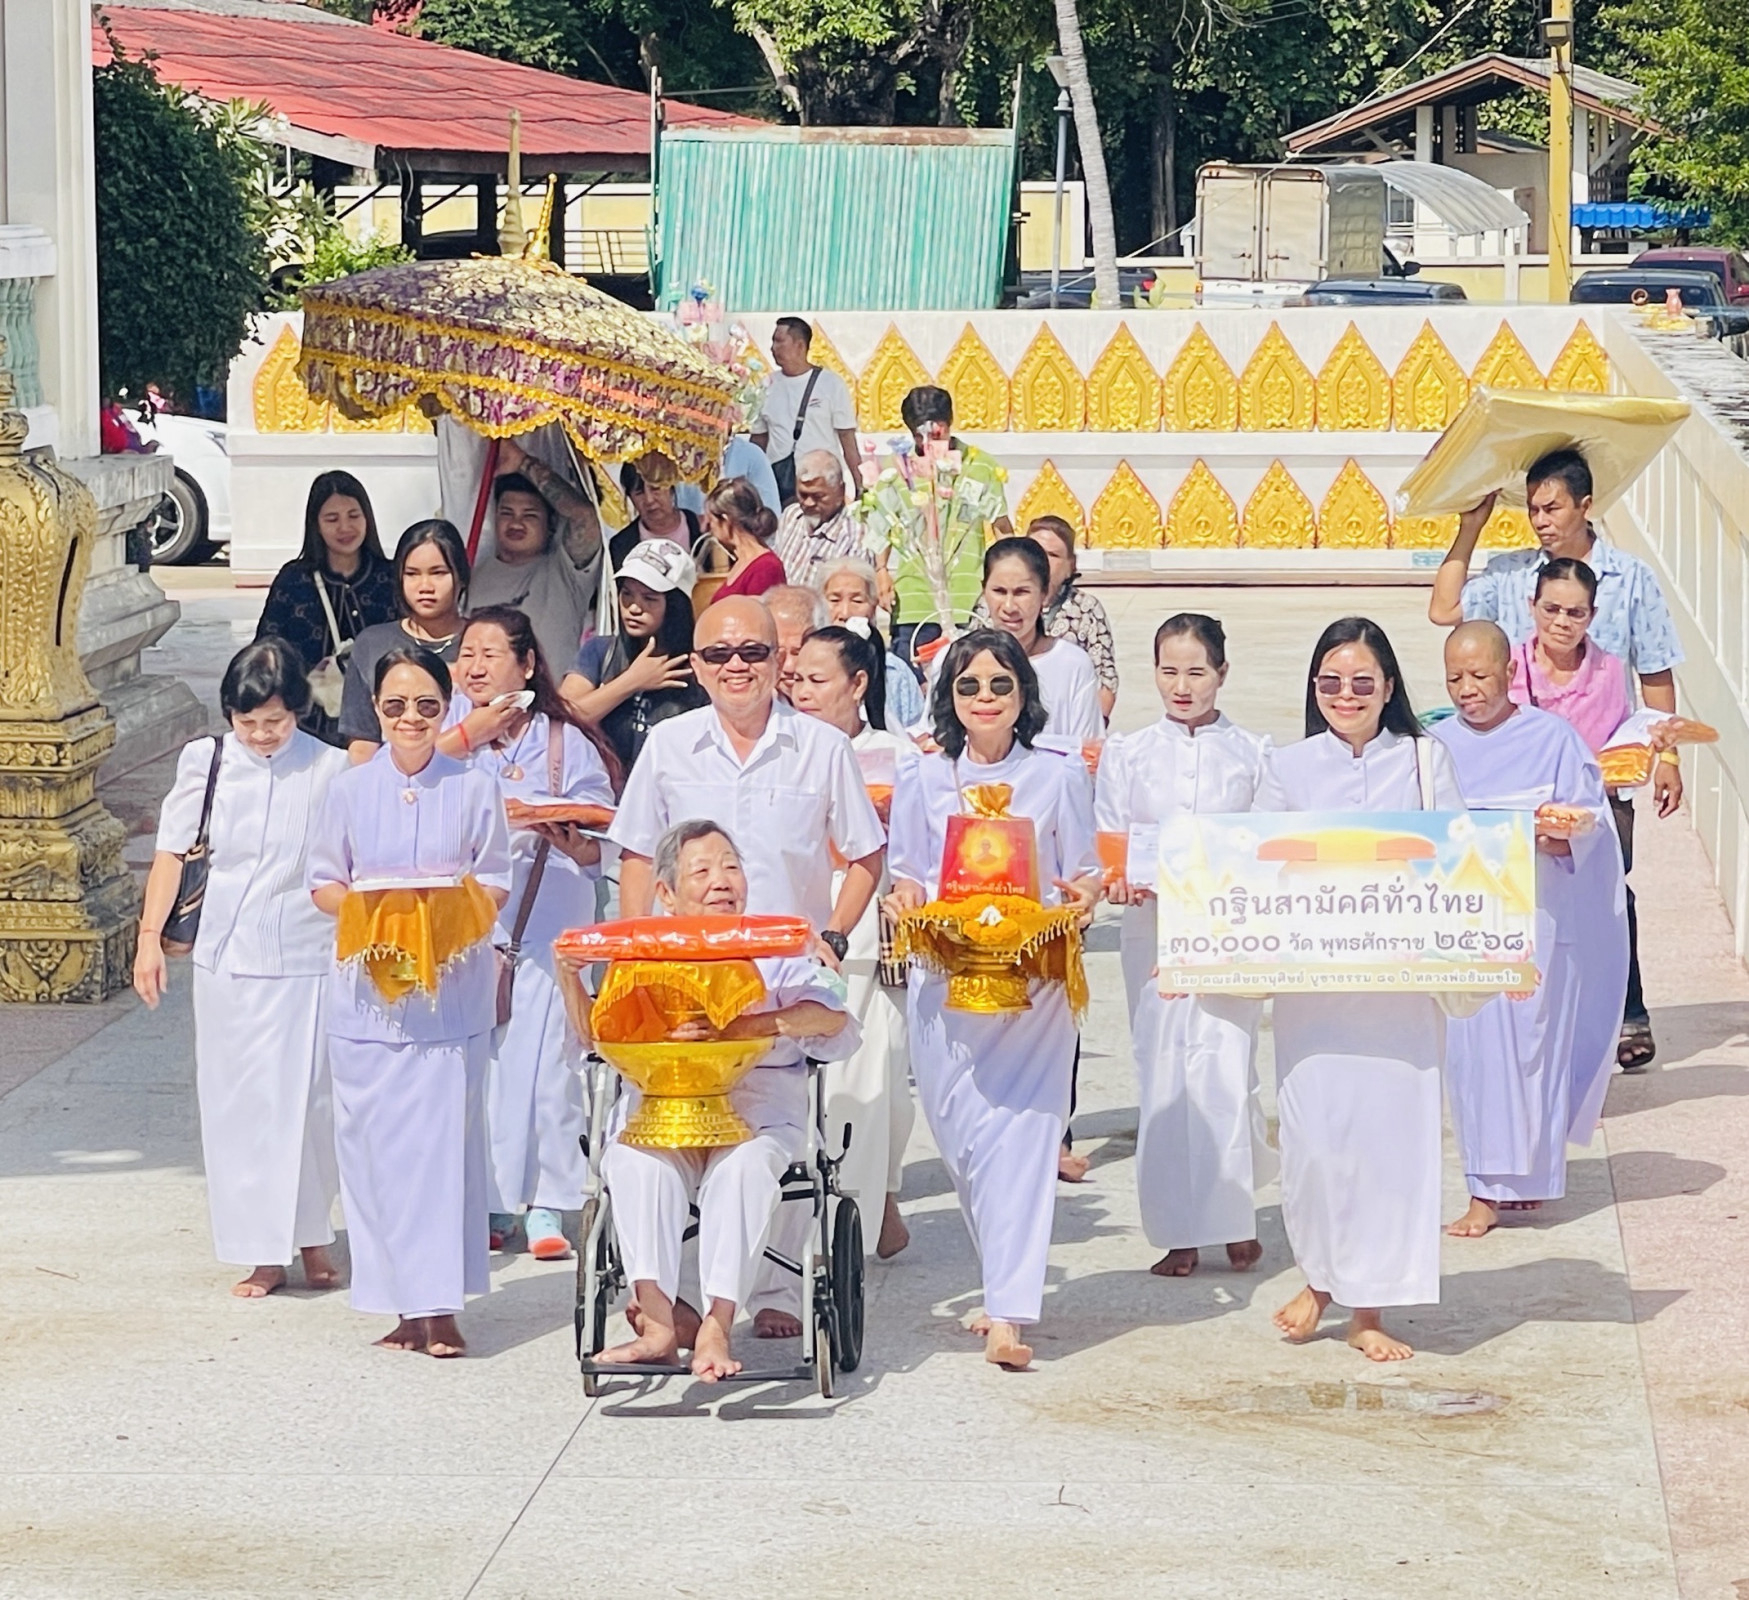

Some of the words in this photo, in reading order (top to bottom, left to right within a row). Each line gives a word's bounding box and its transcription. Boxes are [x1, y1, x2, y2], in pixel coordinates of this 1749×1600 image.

[1209, 876, 1483, 925] กฐินสามัคคีทั่วไทย
[1170, 935, 1280, 956] ๓๐,๐๐๐
[1289, 932, 1313, 951] วัด
[1320, 932, 1425, 957] พุทธศักราช
[1434, 930, 1524, 951] ๒๕๖๘
[1175, 973, 1198, 985] โดย
[1310, 973, 1371, 987] บูชาธรรม
[1401, 970, 1410, 983] ปี
